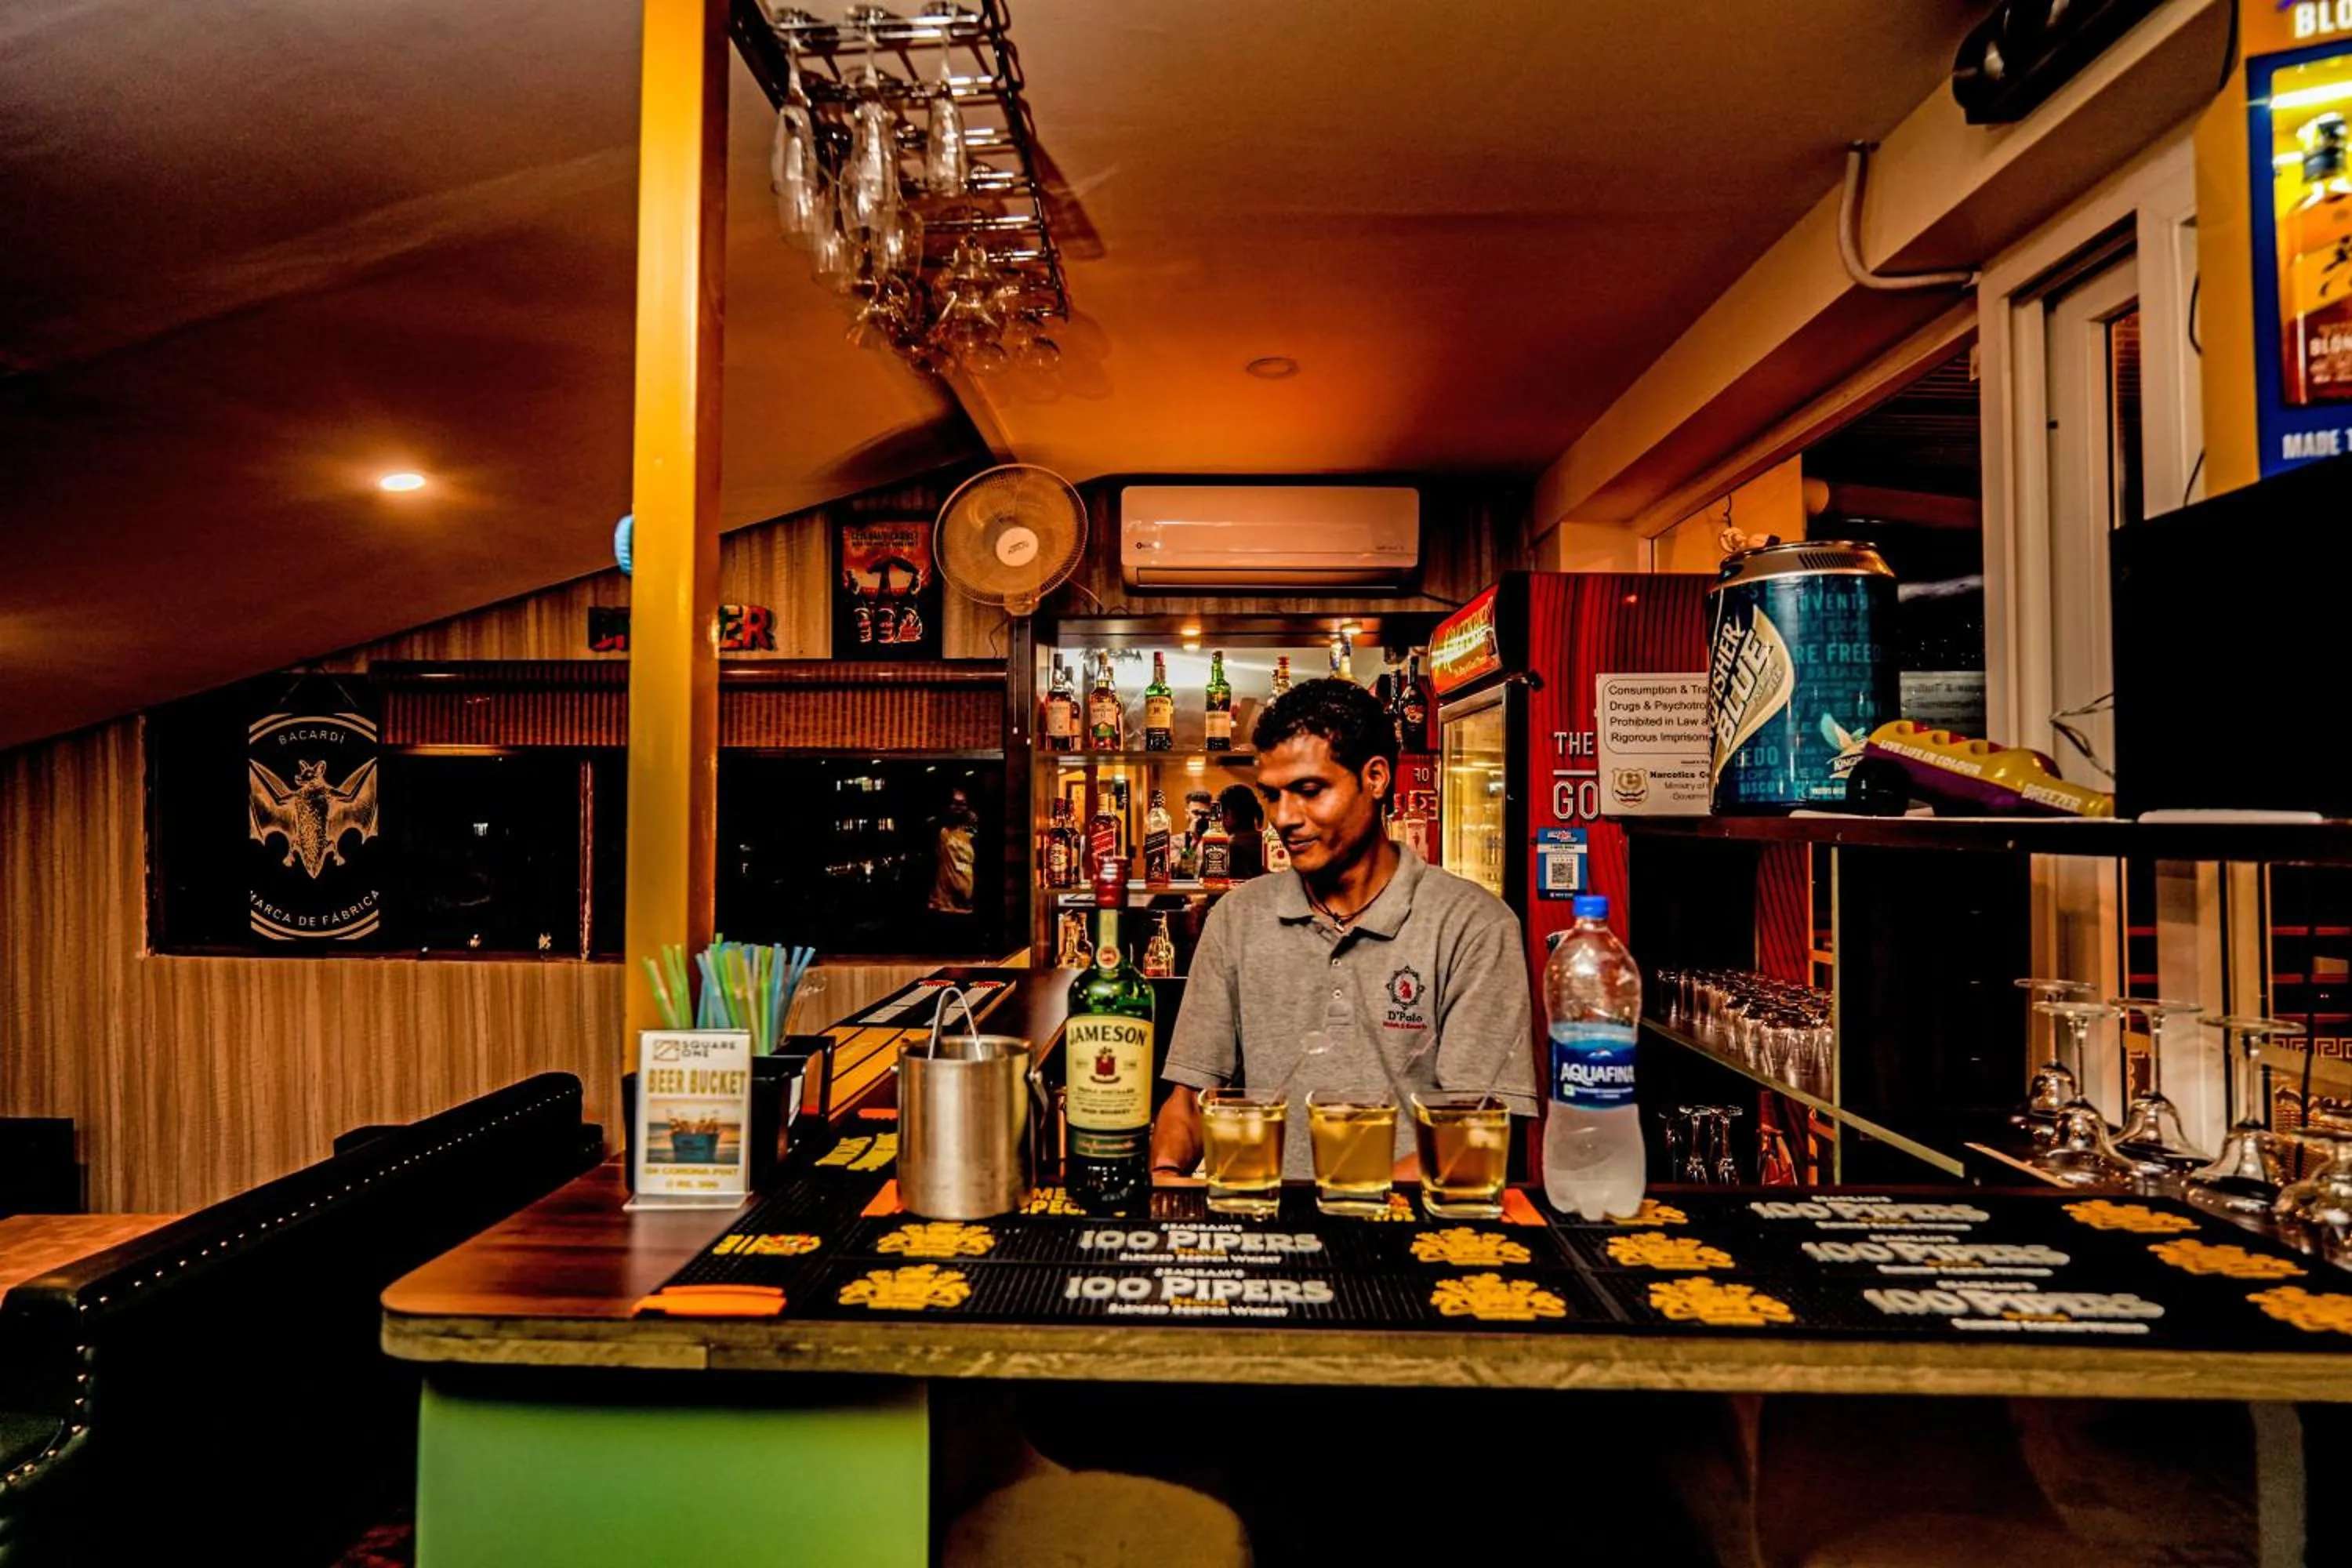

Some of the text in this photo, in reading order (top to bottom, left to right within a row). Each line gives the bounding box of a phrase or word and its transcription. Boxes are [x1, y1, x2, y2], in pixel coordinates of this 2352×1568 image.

[2282, 430, 2340, 459] MADE
[1609, 684, 1677, 696] Consumption
[1681, 685, 1687, 694] &
[1610, 700, 1641, 712] Drugs
[1643, 700, 1651, 710] &
[1610, 717, 1662, 726] Prohibited
[1665, 717, 1674, 725] in
[1678, 717, 1698, 726] Law
[1553, 731, 1594, 755] THE
[1611, 732, 1657, 743] Rigorous
[2021, 782, 2082, 813] BREEZER
[299, 916, 315, 926] DE
[1069, 1025, 1148, 1046] JAMESON
[648, 1068, 746, 1094] BEER BUCKET
[1560, 1062, 1635, 1087] AQUAFINA
[1080, 1229, 1323, 1253] 100 PIPERS
[1065, 1276, 1334, 1304] 100 PIPERS
